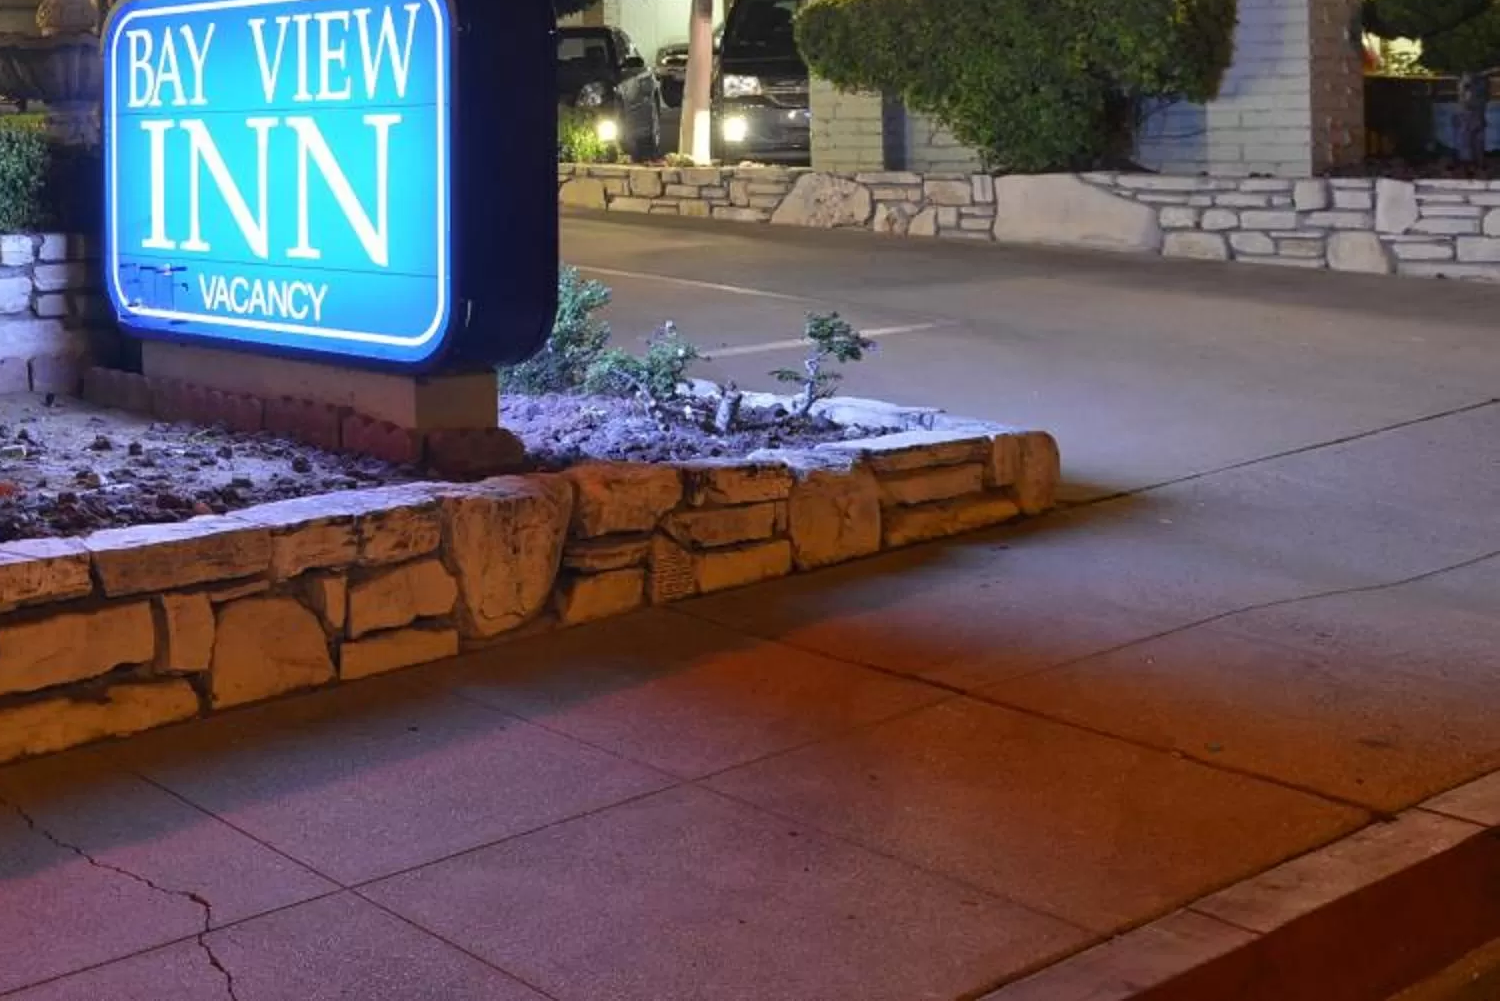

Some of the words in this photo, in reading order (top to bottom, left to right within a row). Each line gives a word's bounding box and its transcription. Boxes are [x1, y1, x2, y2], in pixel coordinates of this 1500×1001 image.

[125, 22, 216, 108] BAY
[248, 3, 421, 103] VIEW
[140, 114, 402, 267] INN
[198, 274, 328, 321] VACANCY
